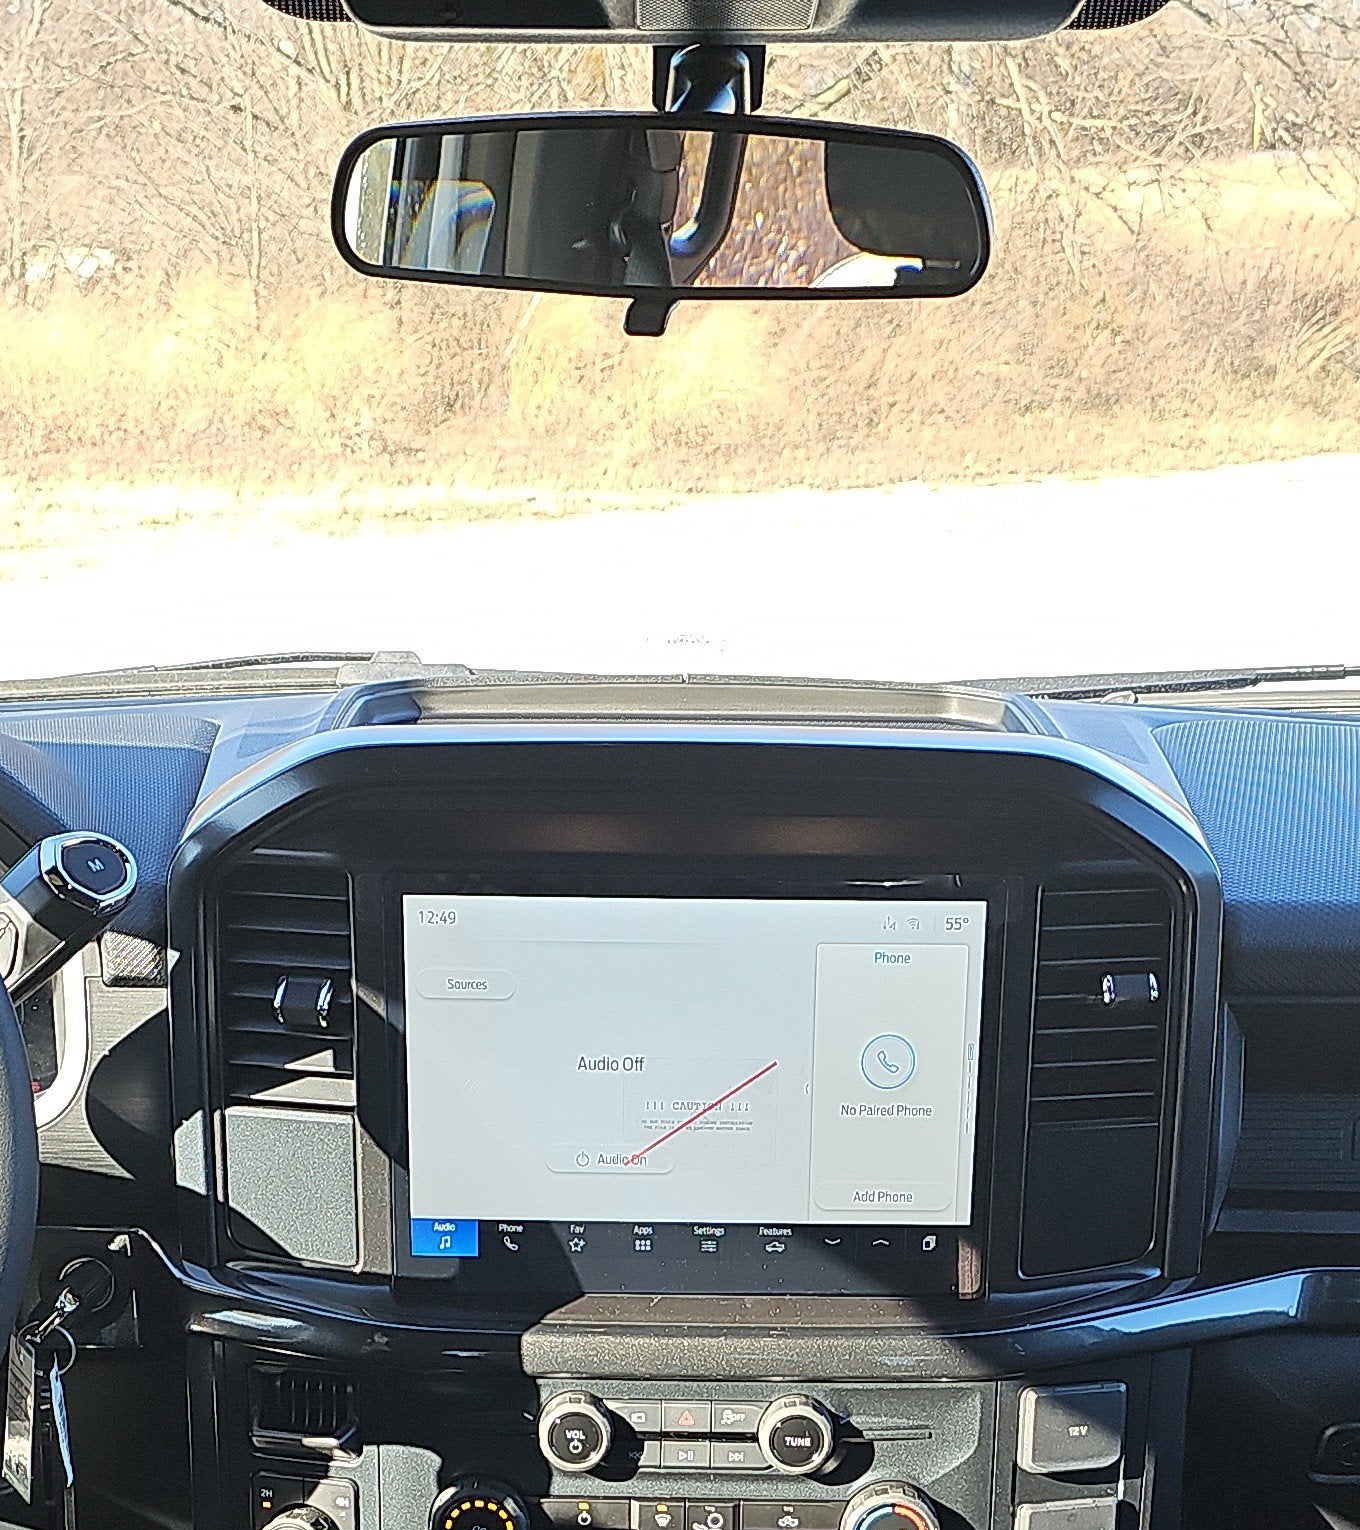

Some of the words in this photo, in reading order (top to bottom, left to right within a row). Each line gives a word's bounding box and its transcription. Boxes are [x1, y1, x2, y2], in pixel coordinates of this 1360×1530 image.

[87, 858, 105, 873] M
[418, 910, 457, 925] 12:49
[874, 952, 911, 964] Phone
[447, 978, 488, 990] Sources
[577, 1056, 619, 1071] Audio
[622, 1057, 645, 1071] Off
[840, 1105, 857, 1117] No
[859, 1105, 894, 1117] Paired
[896, 1105, 932, 1118] Phone
[597, 1154, 629, 1166] Audio
[631, 1154, 647, 1166] On
[853, 1191, 876, 1203] Add
[877, 1191, 913, 1204] Phone
[433, 1222, 455, 1232] Audio
[498, 1223, 523, 1233] Phone
[570, 1224, 585, 1234] Fav
[633, 1225, 652, 1236] Apps
[693, 1225, 725, 1237] Settings
[759, 1226, 792, 1236] Features
[565, 1429, 586, 1440] VOL
[1068, 1425, 1088, 1437] 12V
[784, 1436, 811, 1447] TUNE
[260, 1488, 273, 1498] 2H
